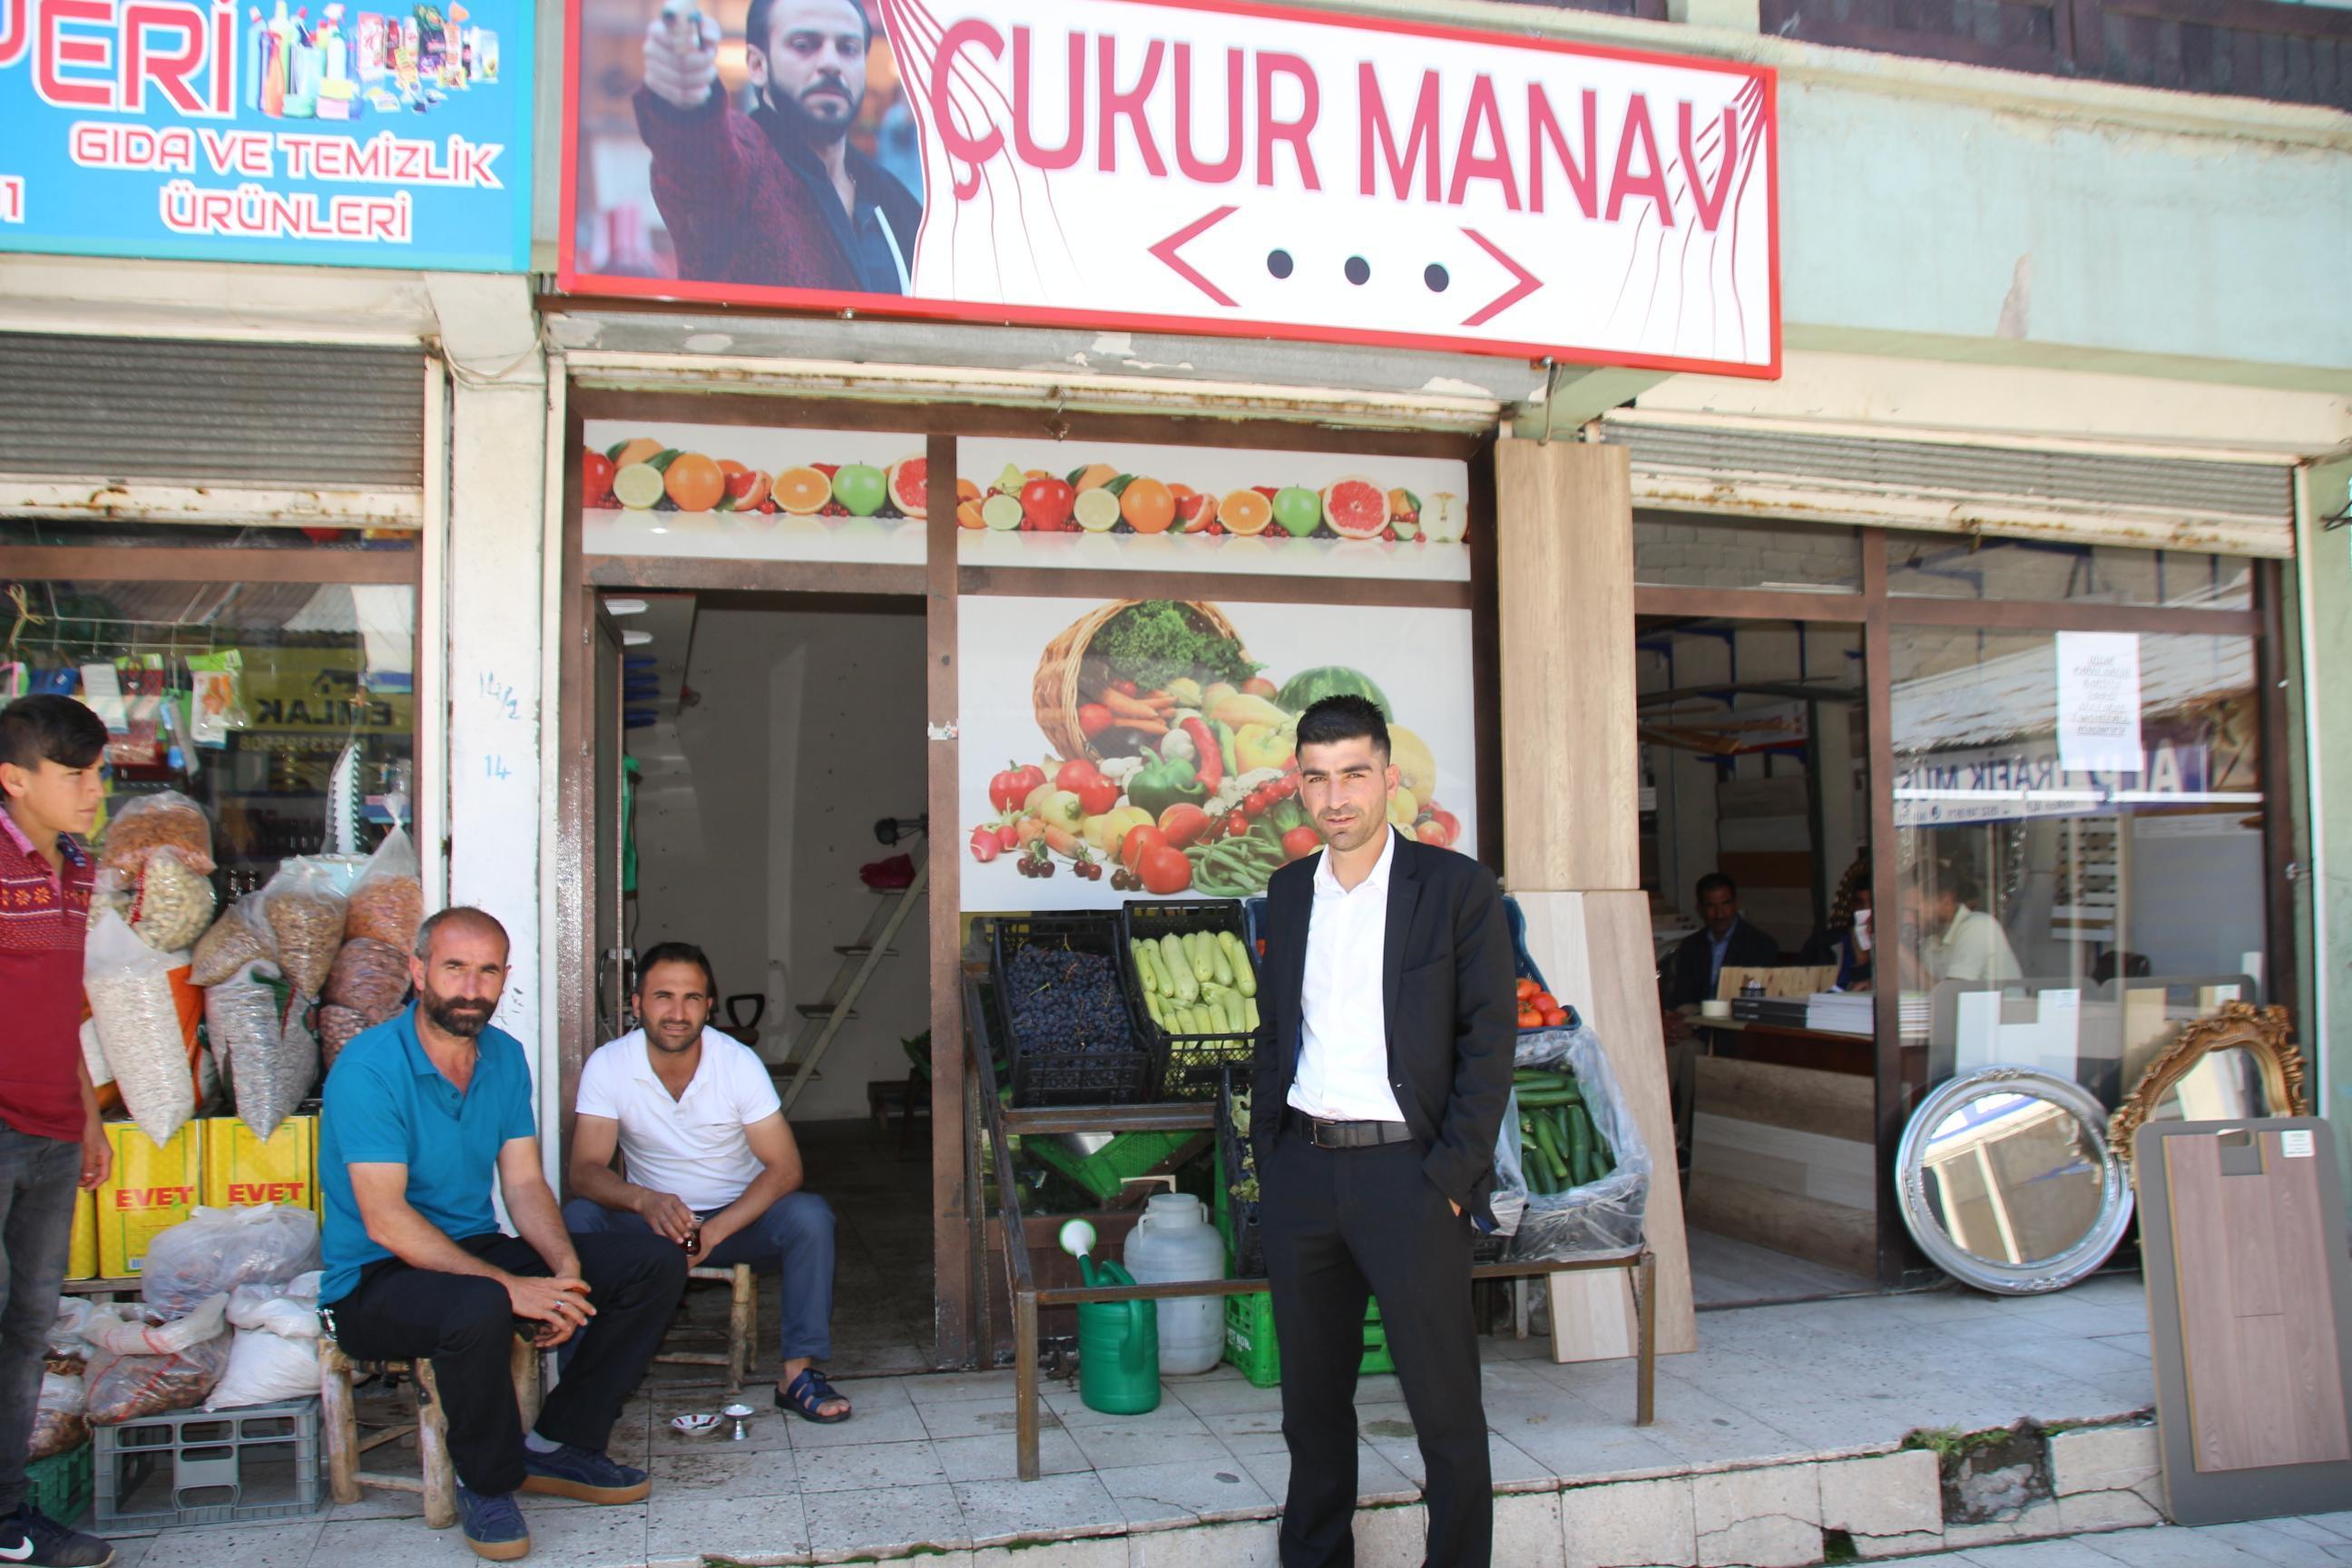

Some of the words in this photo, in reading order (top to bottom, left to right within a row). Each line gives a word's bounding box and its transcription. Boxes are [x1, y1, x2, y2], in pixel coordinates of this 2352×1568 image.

[930, 18, 1322, 201] ÇUKUR
[1357, 60, 1737, 232] MANAV
[77, 126, 191, 167] GIDA
[205, 135, 270, 173] VE
[281, 136, 494, 182] TEMİZLİK
[166, 187, 407, 238] ÜRÜNLERİ
[115, 1185, 195, 1208] EVET
[228, 1182, 304, 1202] EVET
